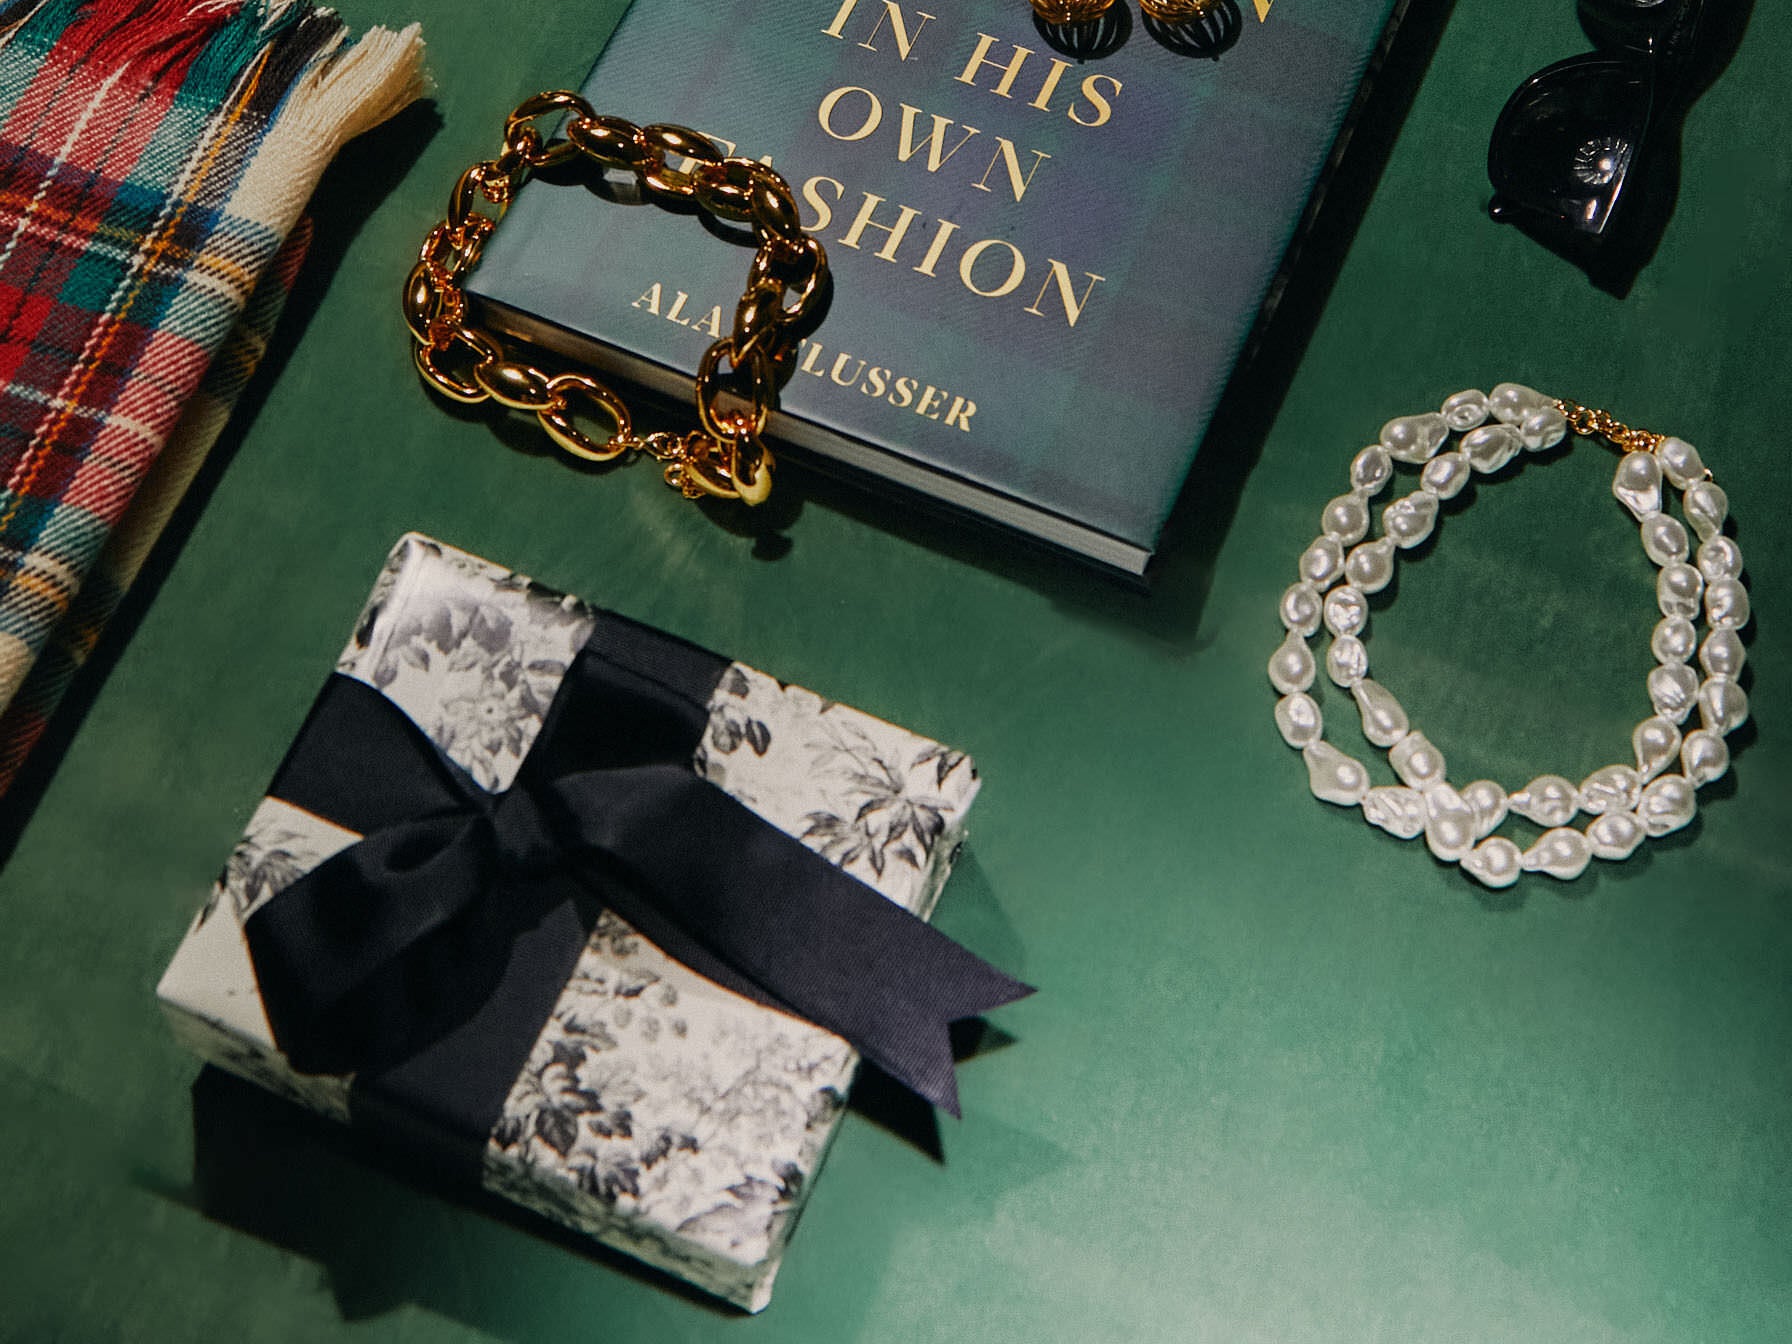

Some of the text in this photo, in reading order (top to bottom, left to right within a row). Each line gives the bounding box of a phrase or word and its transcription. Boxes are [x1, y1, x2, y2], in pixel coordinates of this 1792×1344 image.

[953, 32, 1124, 128] HIS
[817, 85, 1052, 203] OWN
[677, 131, 1106, 328] SHION
[797, 338, 979, 433] LUSSER
